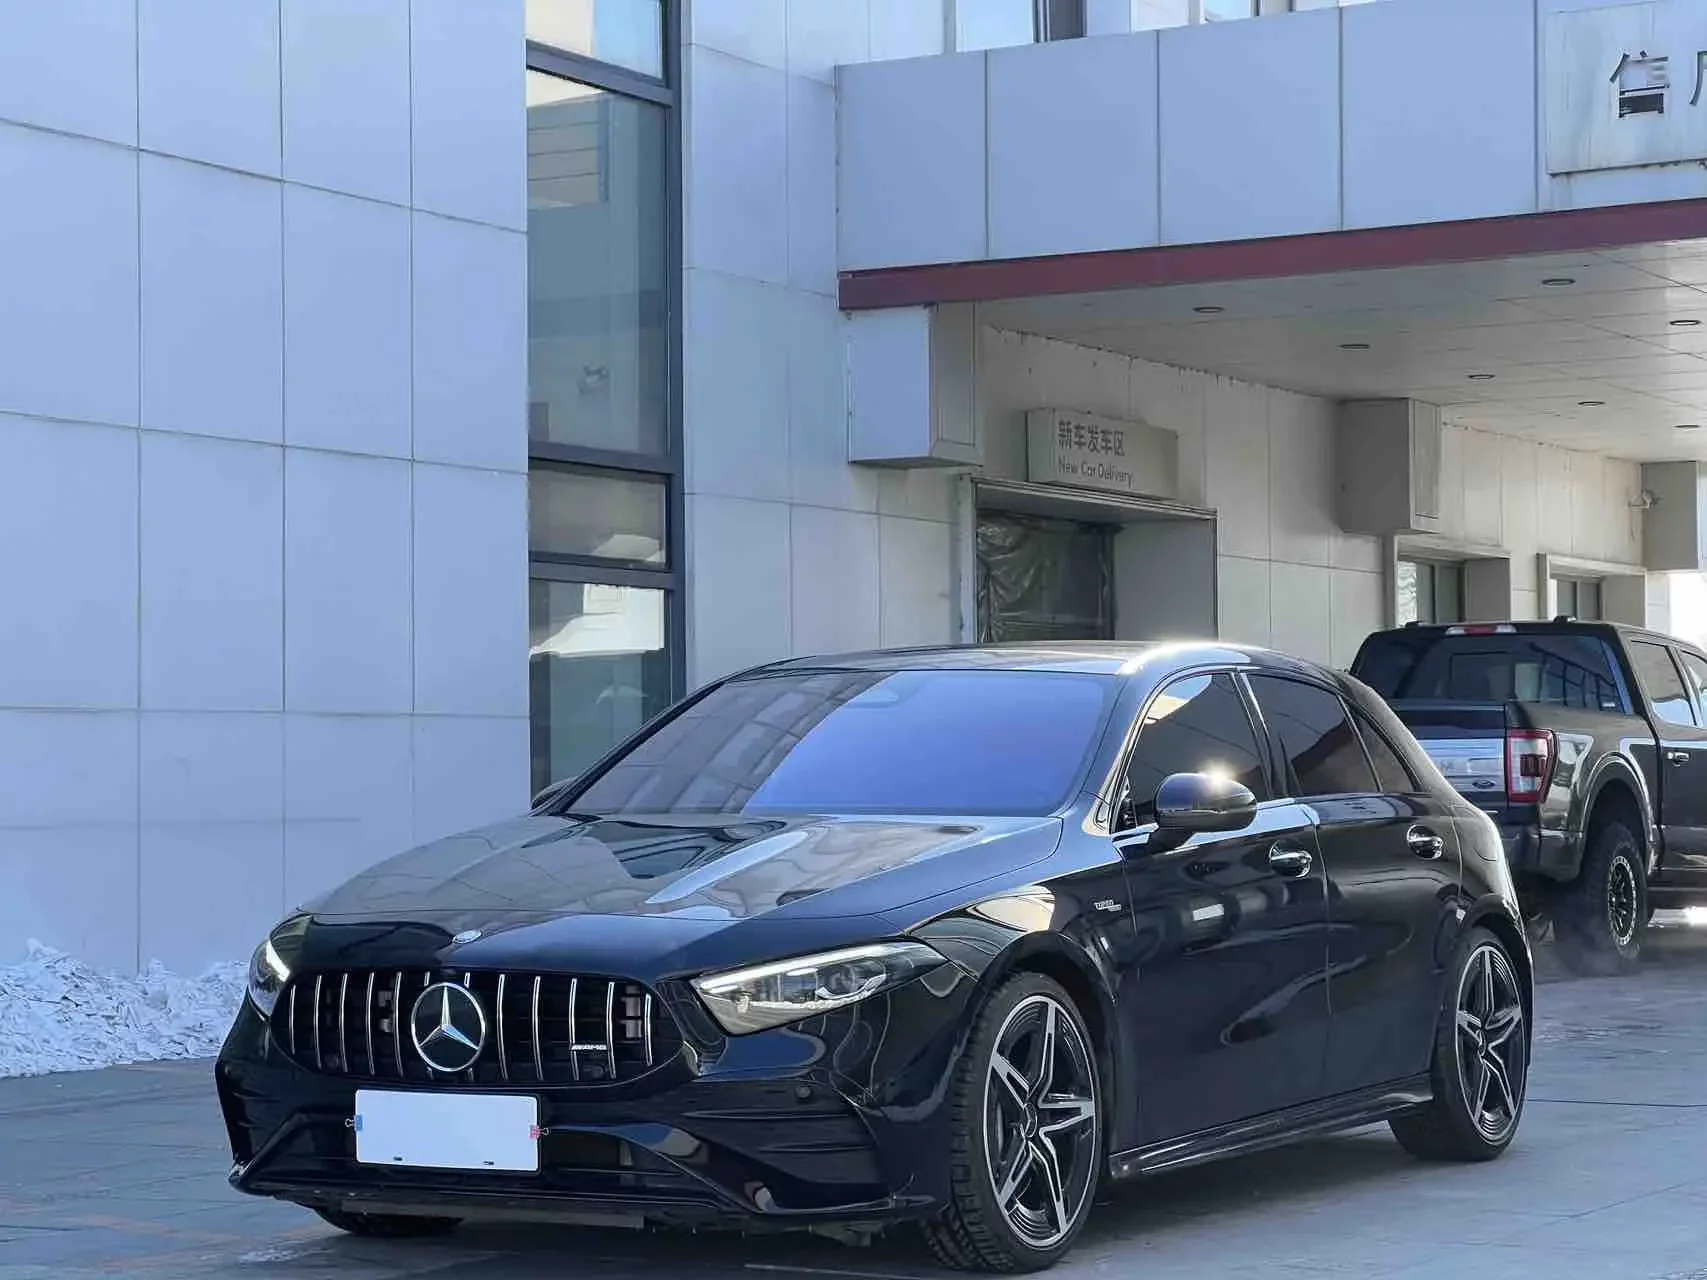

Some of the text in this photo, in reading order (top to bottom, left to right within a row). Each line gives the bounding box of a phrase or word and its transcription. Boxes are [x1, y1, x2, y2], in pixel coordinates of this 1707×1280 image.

[1058, 420, 1126, 456] 新车发车区
[1058, 455, 1133, 488] New Car Delivery
